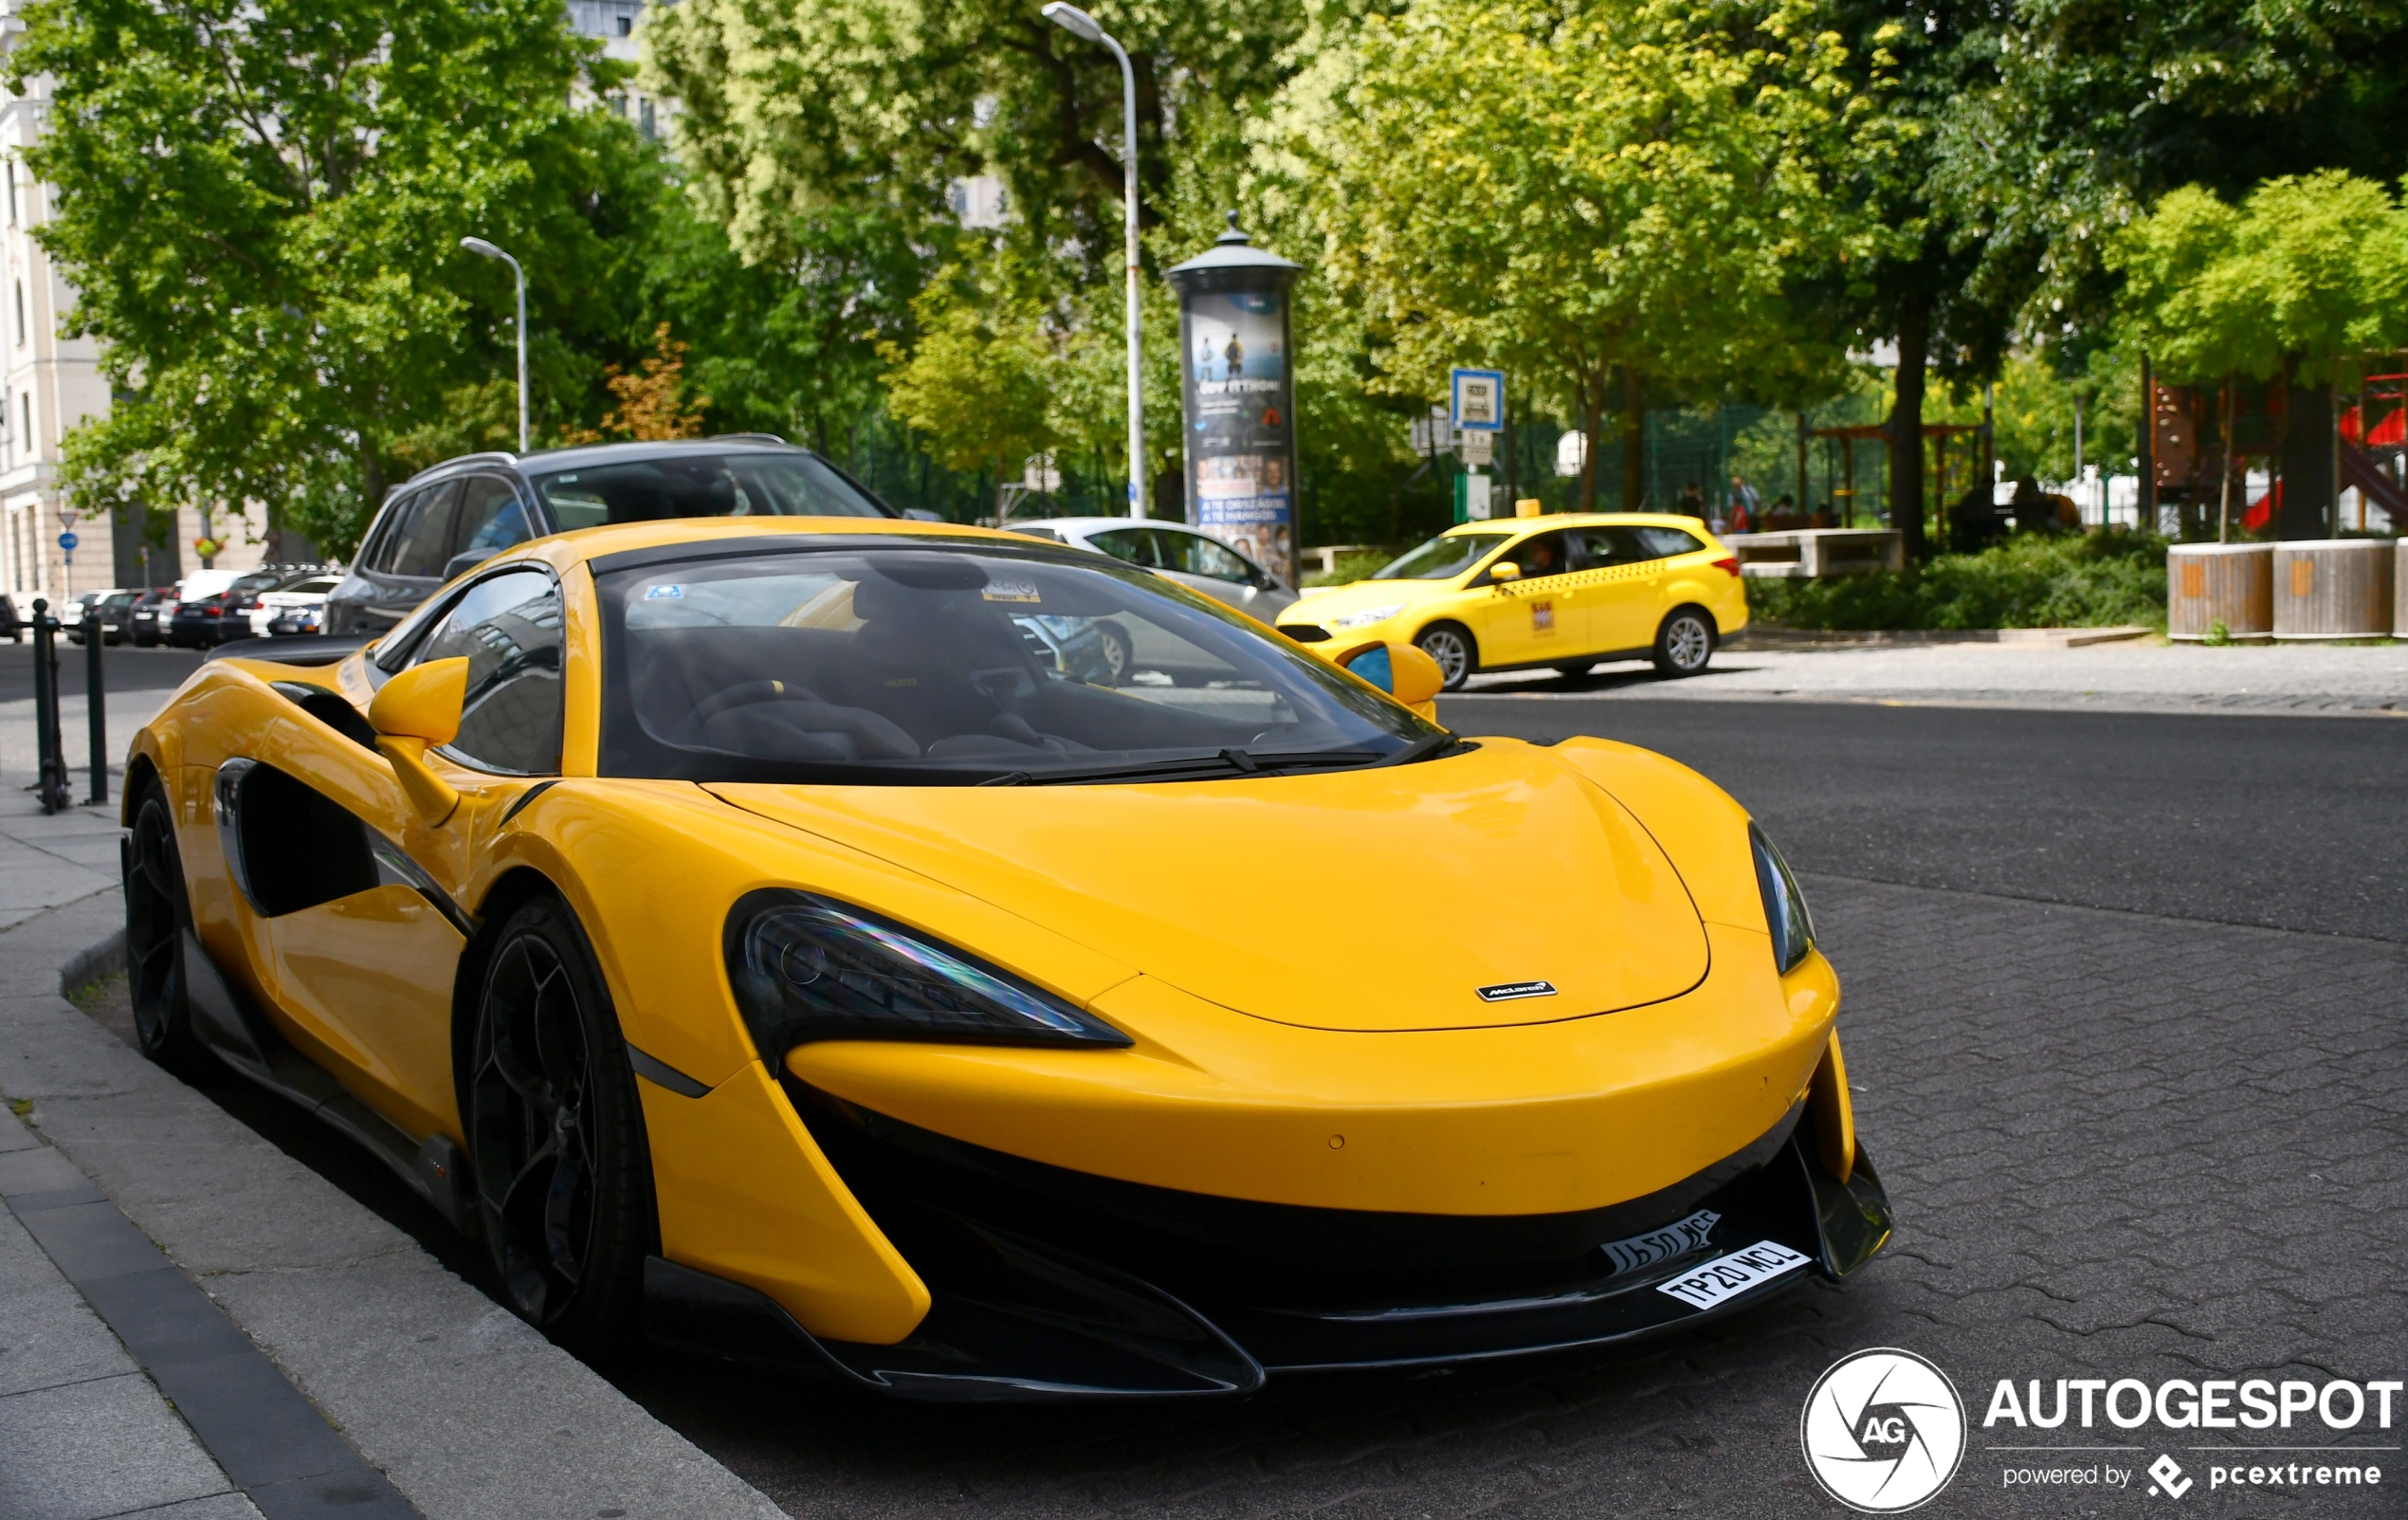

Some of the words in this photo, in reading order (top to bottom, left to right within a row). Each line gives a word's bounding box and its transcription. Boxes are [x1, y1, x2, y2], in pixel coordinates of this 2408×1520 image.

[1488, 983, 1545, 997] McLaren
[1667, 1265, 1751, 1302] TP20
[1731, 1246, 1801, 1273] MCL
